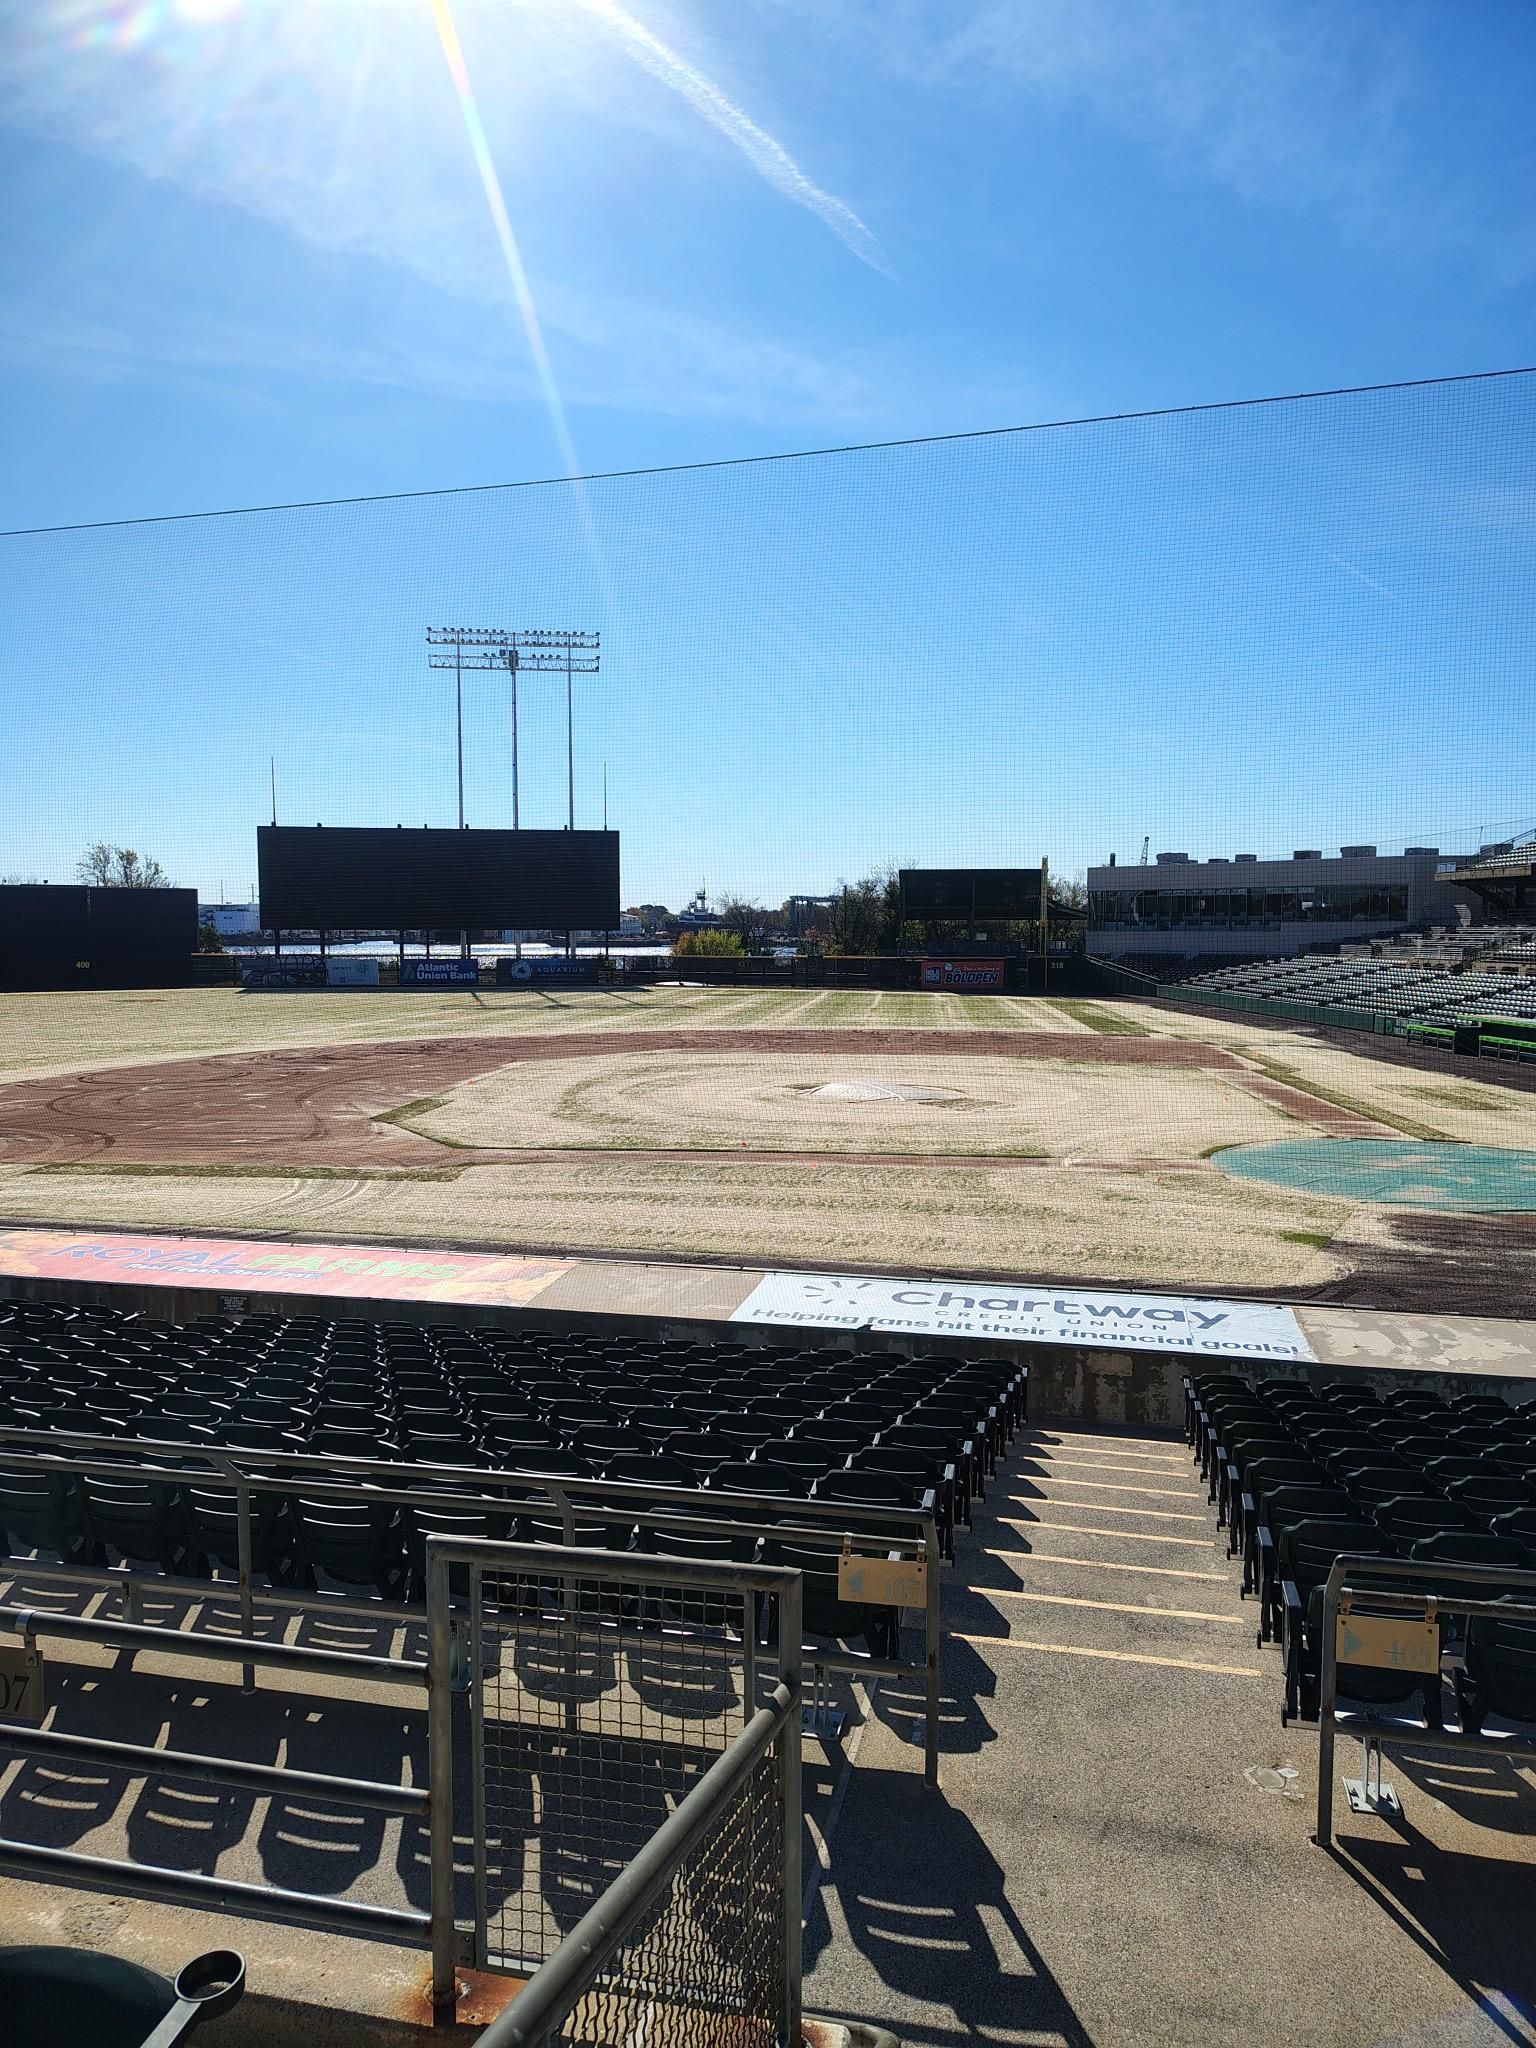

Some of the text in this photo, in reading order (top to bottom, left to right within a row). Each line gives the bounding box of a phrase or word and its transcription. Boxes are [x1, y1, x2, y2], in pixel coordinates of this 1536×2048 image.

[416, 971, 477, 980] Union Bank
[417, 963, 459, 972] Atlantic
[50, 1245, 466, 1279] ROYAL FARMS
[891, 1291, 1230, 1330] Chartway
[934, 1310, 1167, 1331] CREDIT UNION
[752, 1308, 1298, 1354] Helping fans hit their financial goals!
